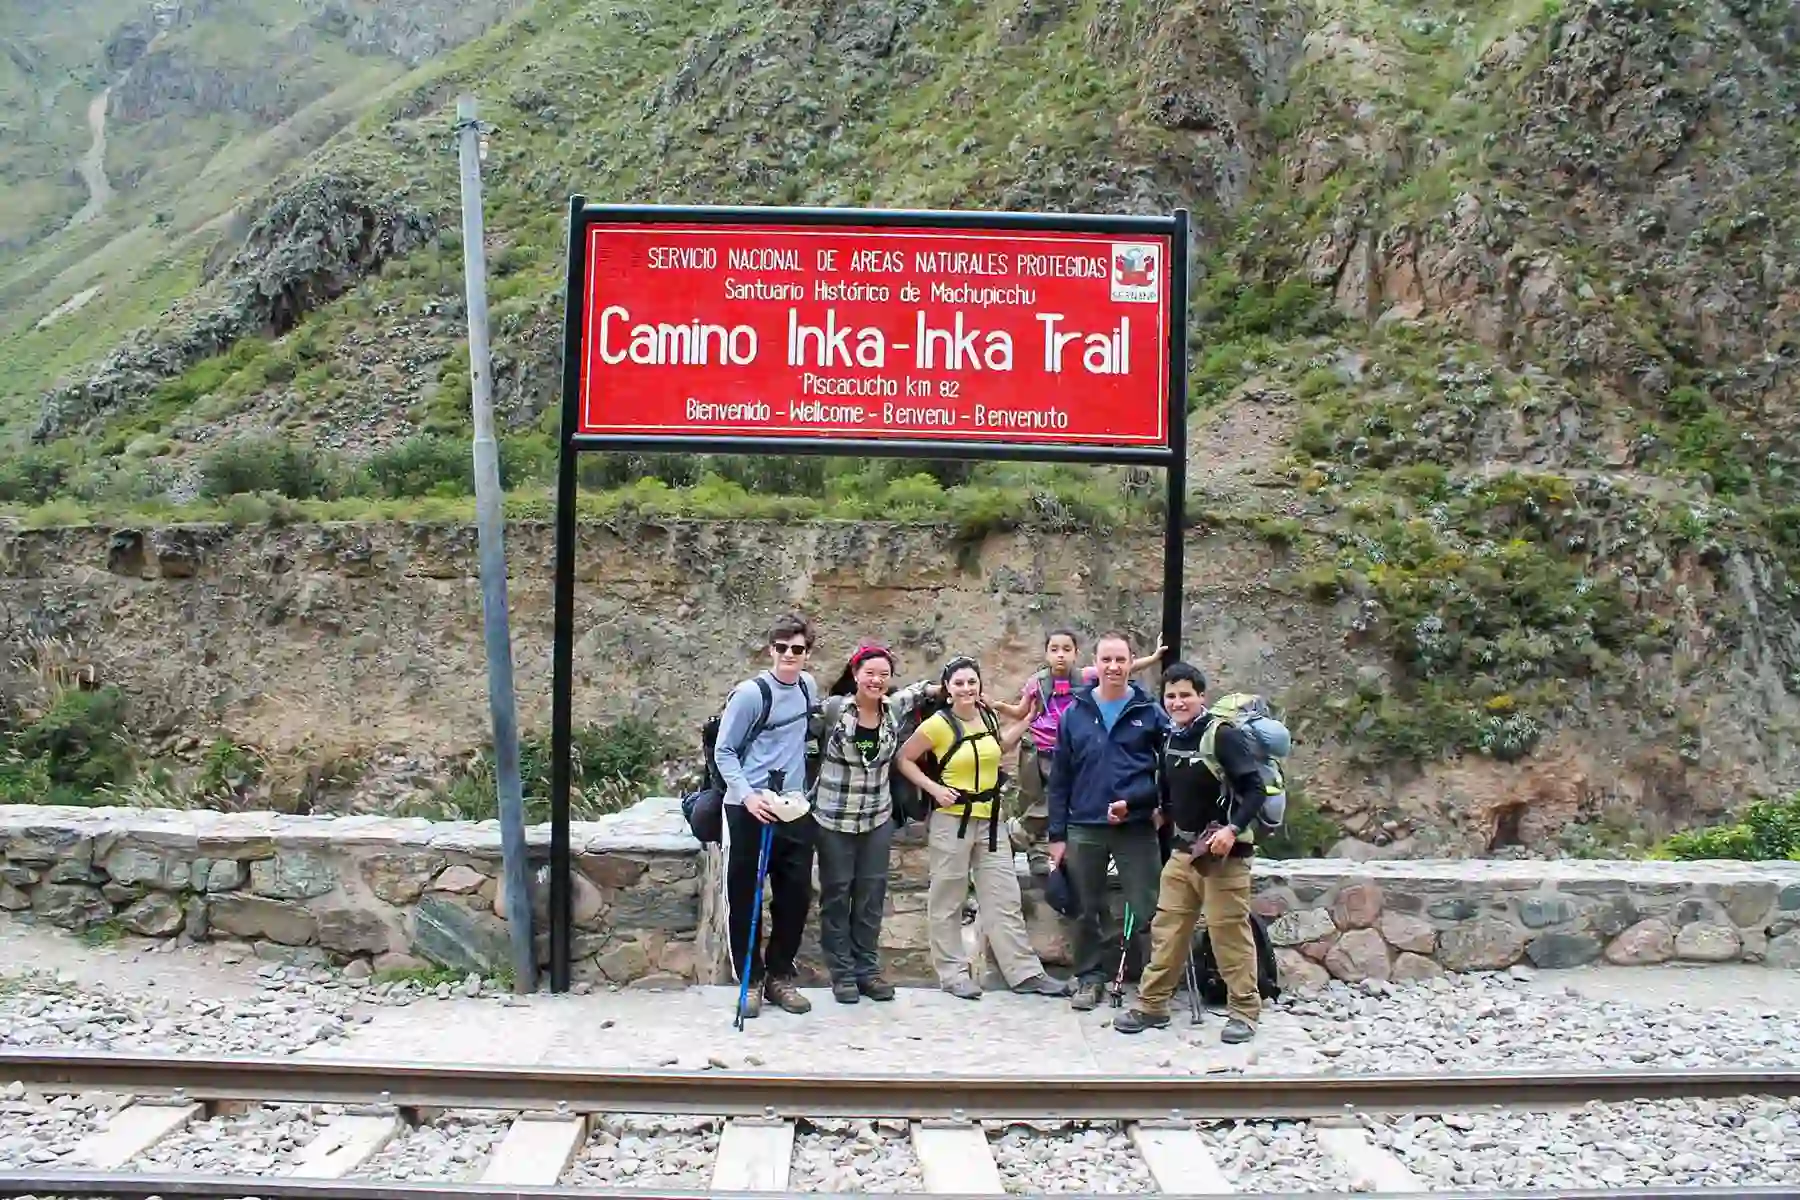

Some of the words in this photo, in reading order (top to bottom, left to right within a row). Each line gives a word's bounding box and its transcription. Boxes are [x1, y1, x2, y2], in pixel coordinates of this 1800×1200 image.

[647, 247, 717, 270] SERVICIO
[728, 248, 804, 271] NACIONAL
[817, 249, 839, 272] DE
[850, 250, 904, 273] AREAS
[915, 251, 1009, 275] NATURALES
[1017, 254, 1108, 279] PROTEGIDAS
[724, 277, 804, 300] Santuario
[814, 279, 890, 302] Histórico
[899, 280, 921, 302] de
[930, 281, 1036, 309] Machupicchu
[599, 305, 758, 366] Camino
[1035, 312, 1130, 375] Trail
[803, 372, 898, 397] Piscacucho
[906, 375, 932, 397] km
[939, 379, 960, 398] 82
[686, 397, 771, 421] Bienvenido
[883, 402, 956, 426] Benvenu
[974, 403, 1068, 429] Benvenuto
